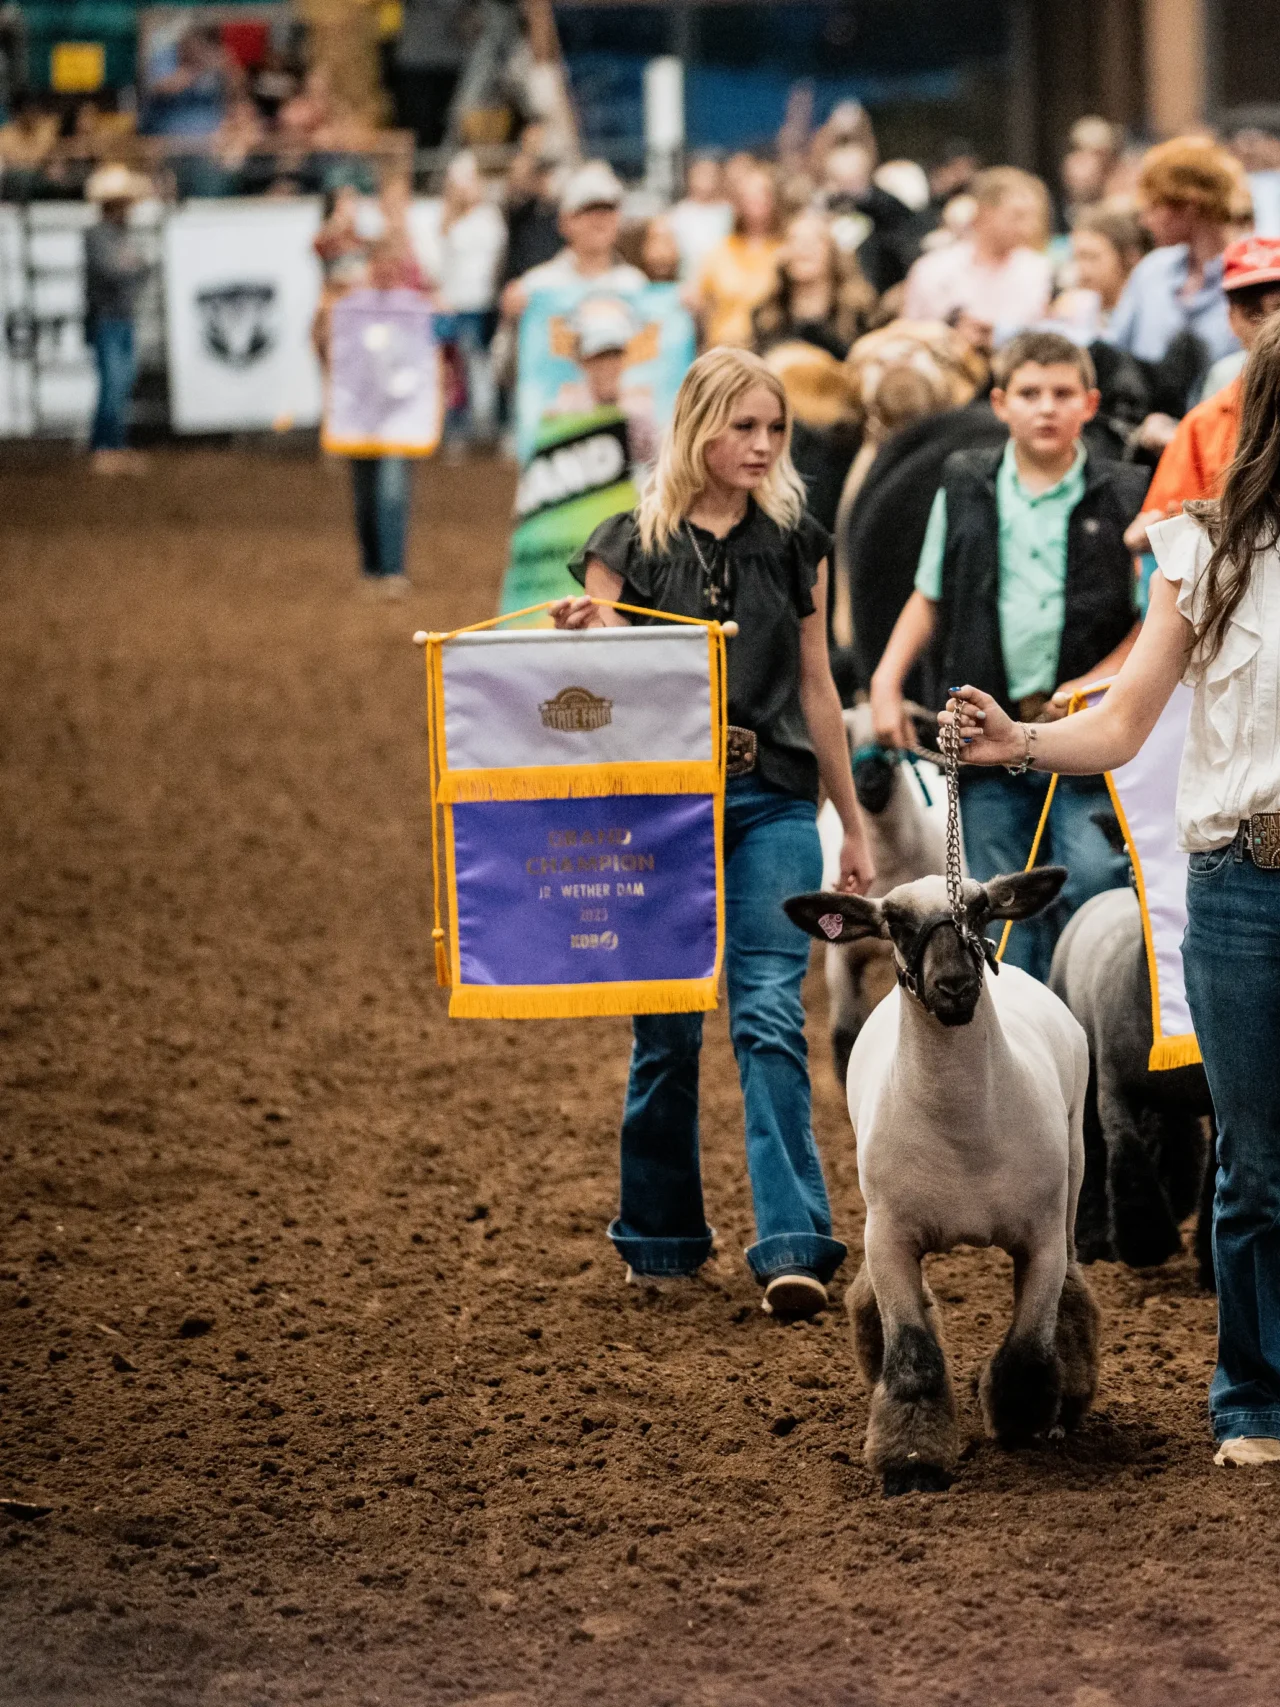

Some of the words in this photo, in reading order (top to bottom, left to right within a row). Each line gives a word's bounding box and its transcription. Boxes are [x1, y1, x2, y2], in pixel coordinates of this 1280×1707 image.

[1262, 815, 1276, 829] ZIA
[548, 828, 632, 847] GRAND
[526, 853, 655, 875] CHAMPION
[561, 883, 610, 899] WETHER
[617, 882, 645, 897] DAM
